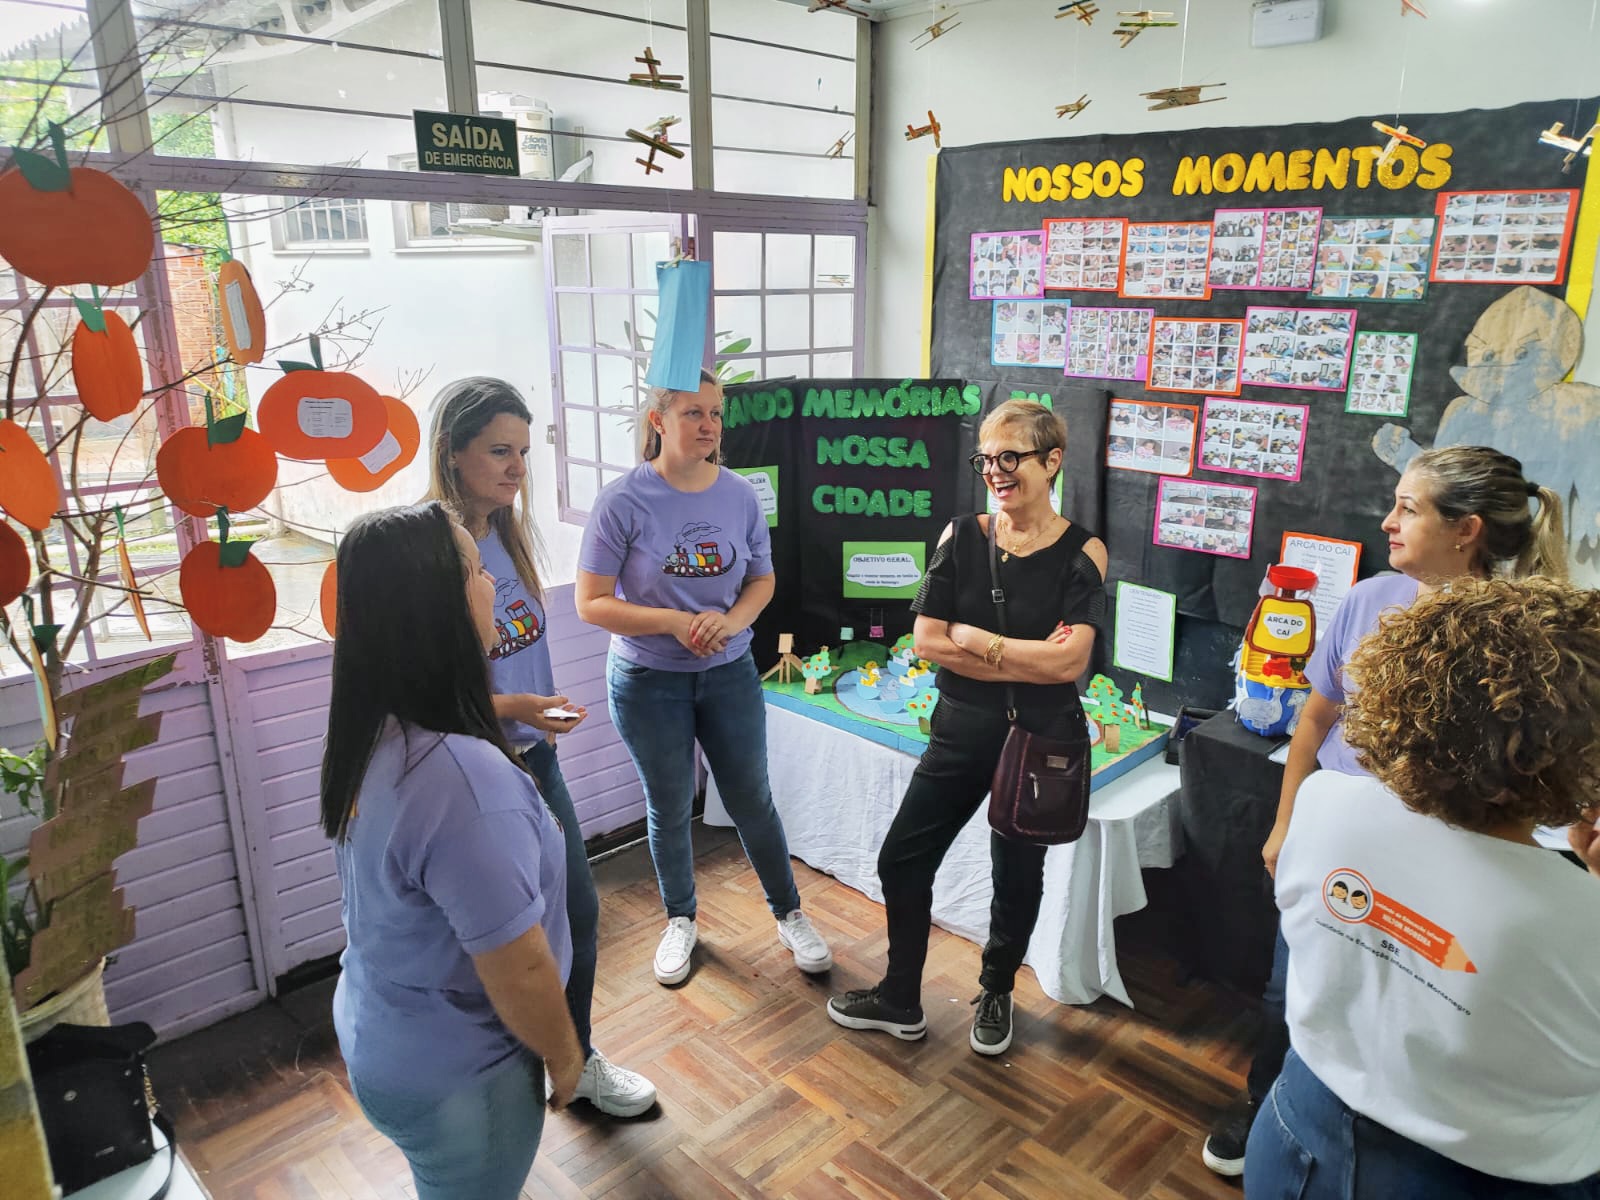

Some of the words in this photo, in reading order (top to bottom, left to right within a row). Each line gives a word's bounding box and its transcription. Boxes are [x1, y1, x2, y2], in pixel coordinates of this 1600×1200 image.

[432, 119, 504, 151] SAÍDA
[425, 151, 441, 165] DE
[444, 152, 514, 170] EMERGÊNCIA
[1003, 158, 1144, 202] NOSSOS
[1172, 143, 1453, 196] MOMENTOS
[802, 378, 981, 418] MEMÓRIAS
[817, 435, 930, 469] NOSSA
[812, 485, 932, 518] CIDADE
[1289, 540, 1316, 551] ARCA
[1318, 543, 1332, 553] DO
[1267, 615, 1290, 625] ARCA
[1290, 618, 1303, 627] DO
